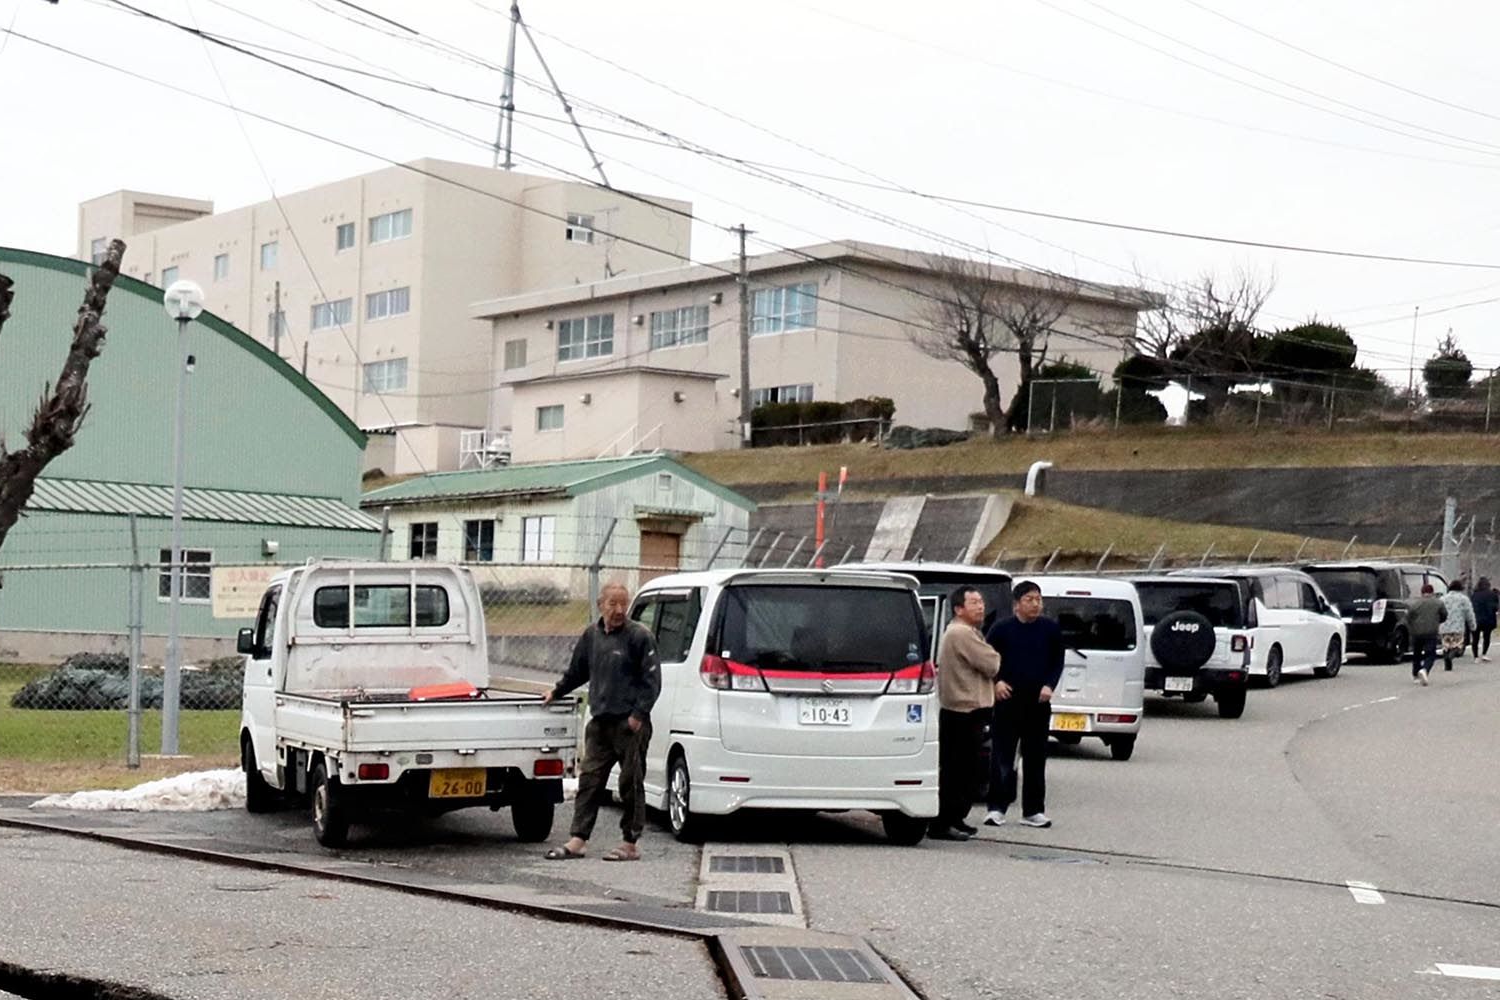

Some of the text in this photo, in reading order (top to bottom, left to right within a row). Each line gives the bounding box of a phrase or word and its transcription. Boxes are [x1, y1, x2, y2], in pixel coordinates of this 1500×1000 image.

[1171, 620, 1199, 634] Jeep
[812, 708, 848, 722] 10-43
[442, 781, 483, 796] 26-00
